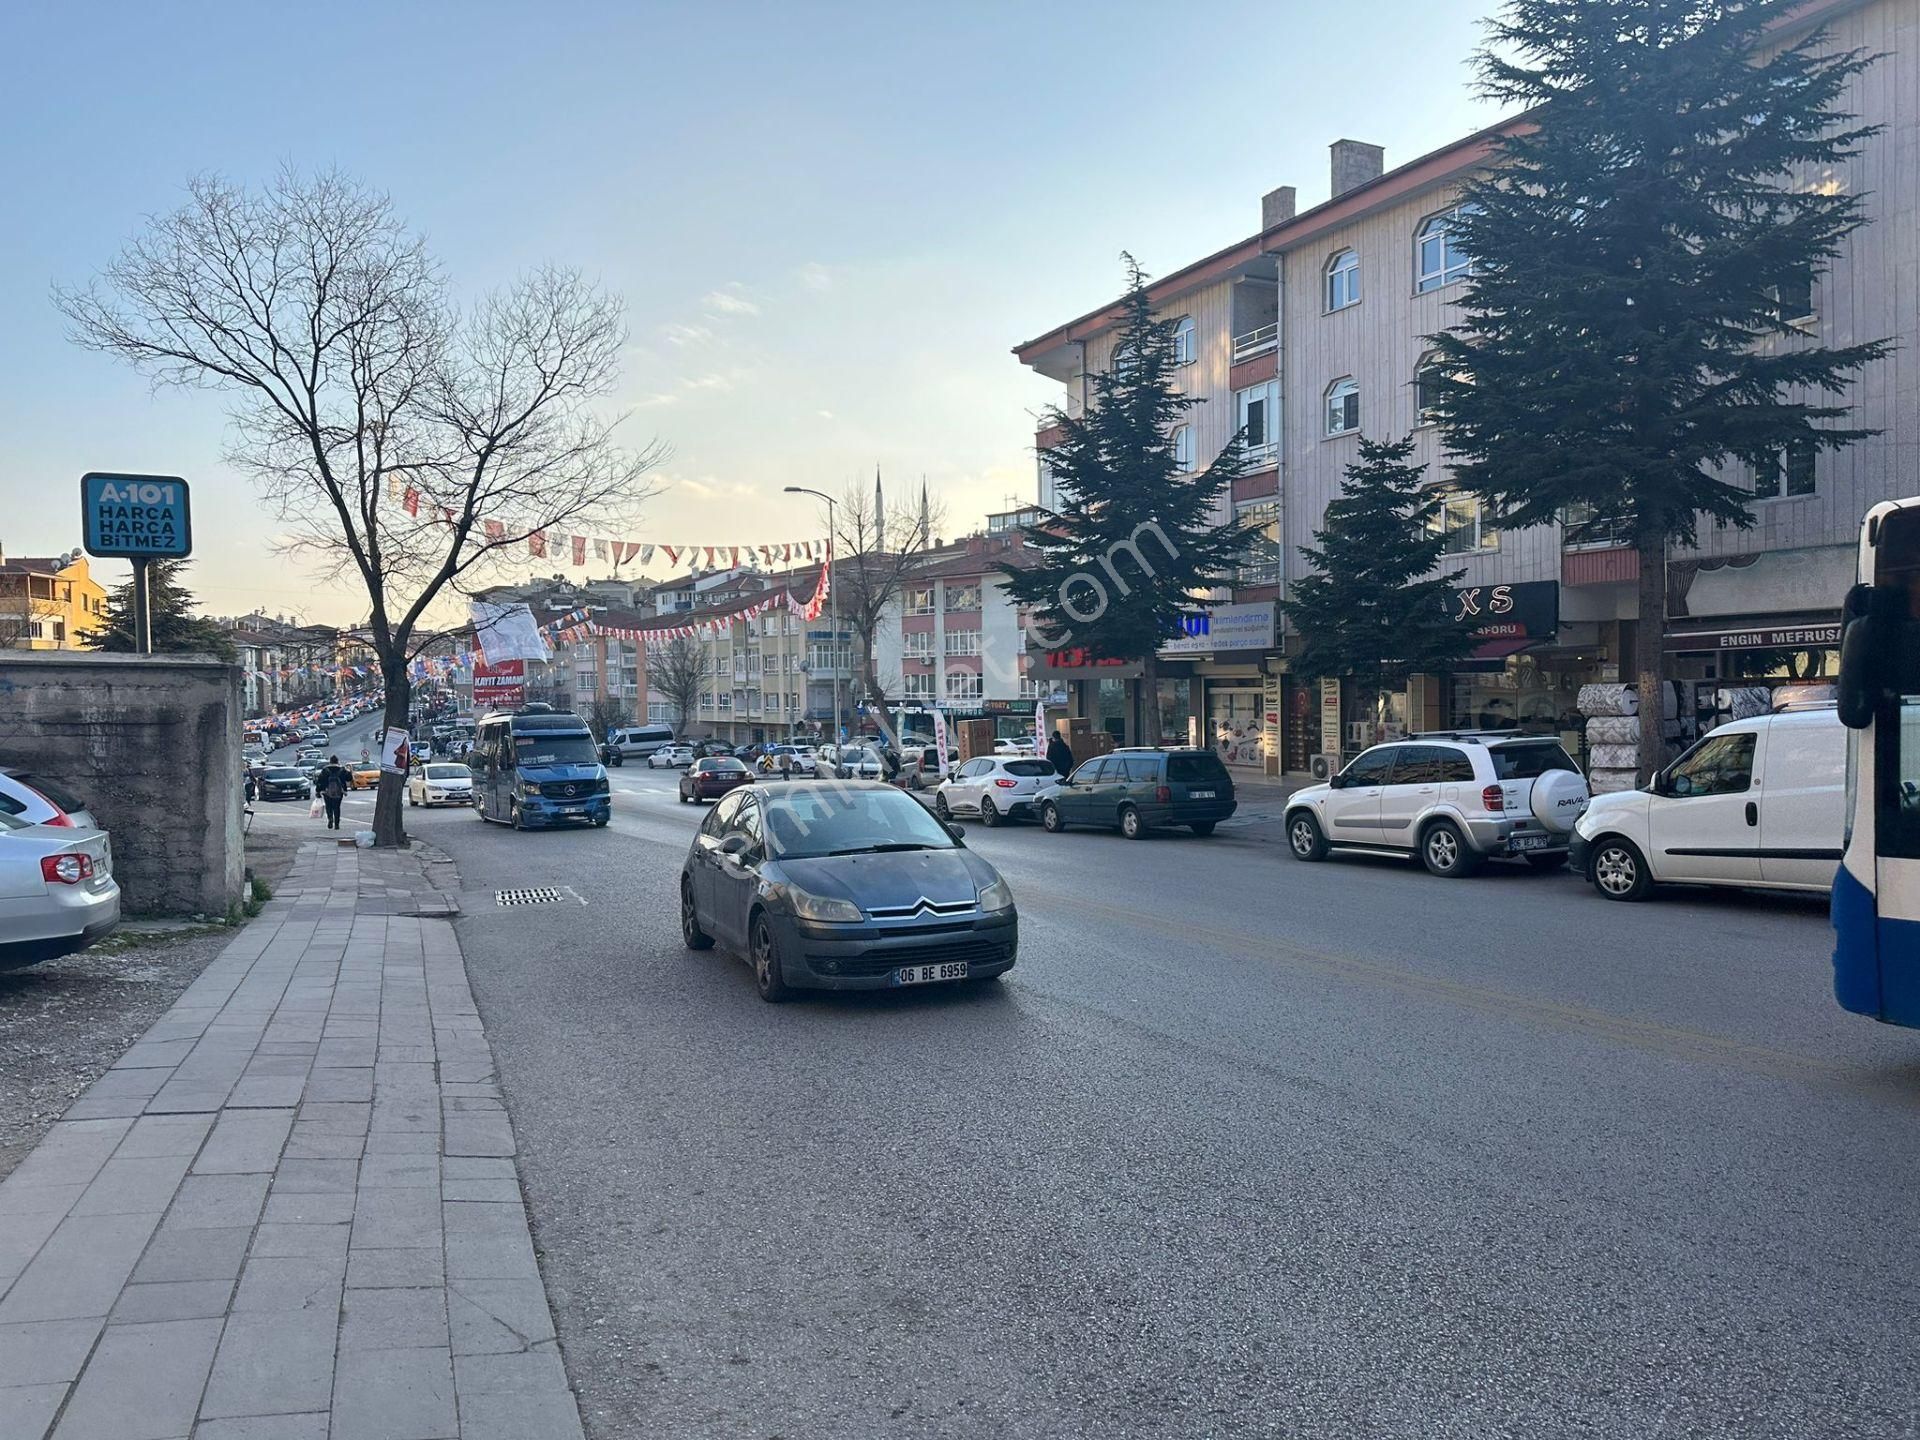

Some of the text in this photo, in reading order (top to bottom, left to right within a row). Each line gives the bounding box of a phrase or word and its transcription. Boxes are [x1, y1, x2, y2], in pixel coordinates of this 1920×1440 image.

[100, 506, 174, 520] HARCA
[100, 520, 174, 535] HARCA
[901, 963, 967, 982] 06 BE 6959
